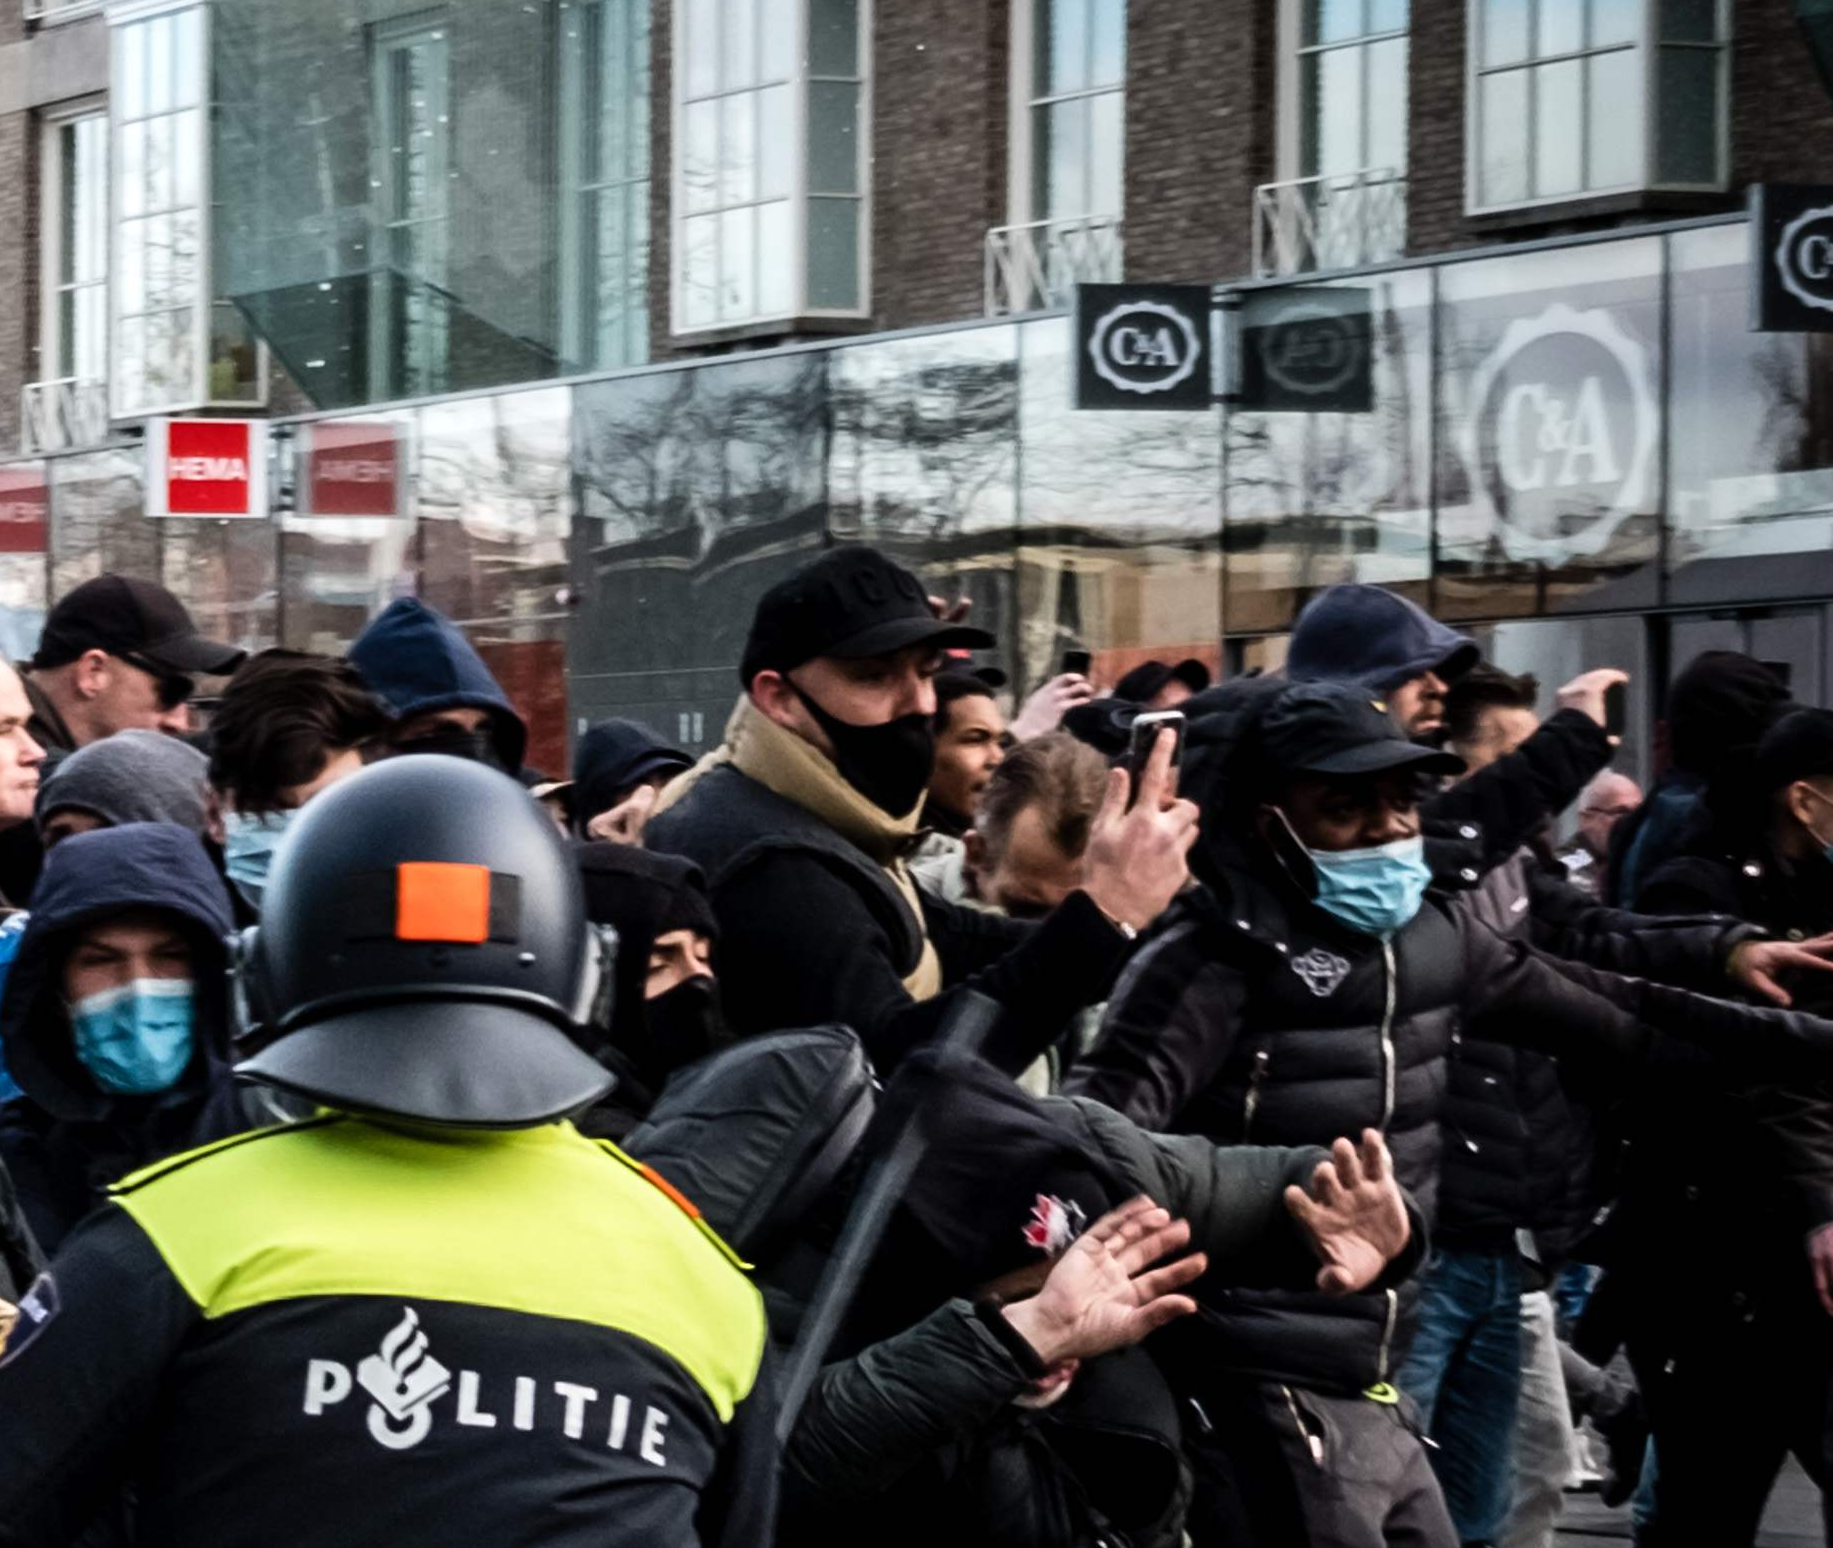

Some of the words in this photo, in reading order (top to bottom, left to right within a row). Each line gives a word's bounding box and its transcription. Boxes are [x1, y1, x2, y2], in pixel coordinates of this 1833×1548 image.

[1110, 327, 1181, 367] C&A
[169, 456, 248, 482] HEMA
[1495, 376, 1621, 490] C&A
[302, 1325, 669, 1468] POLITIE
